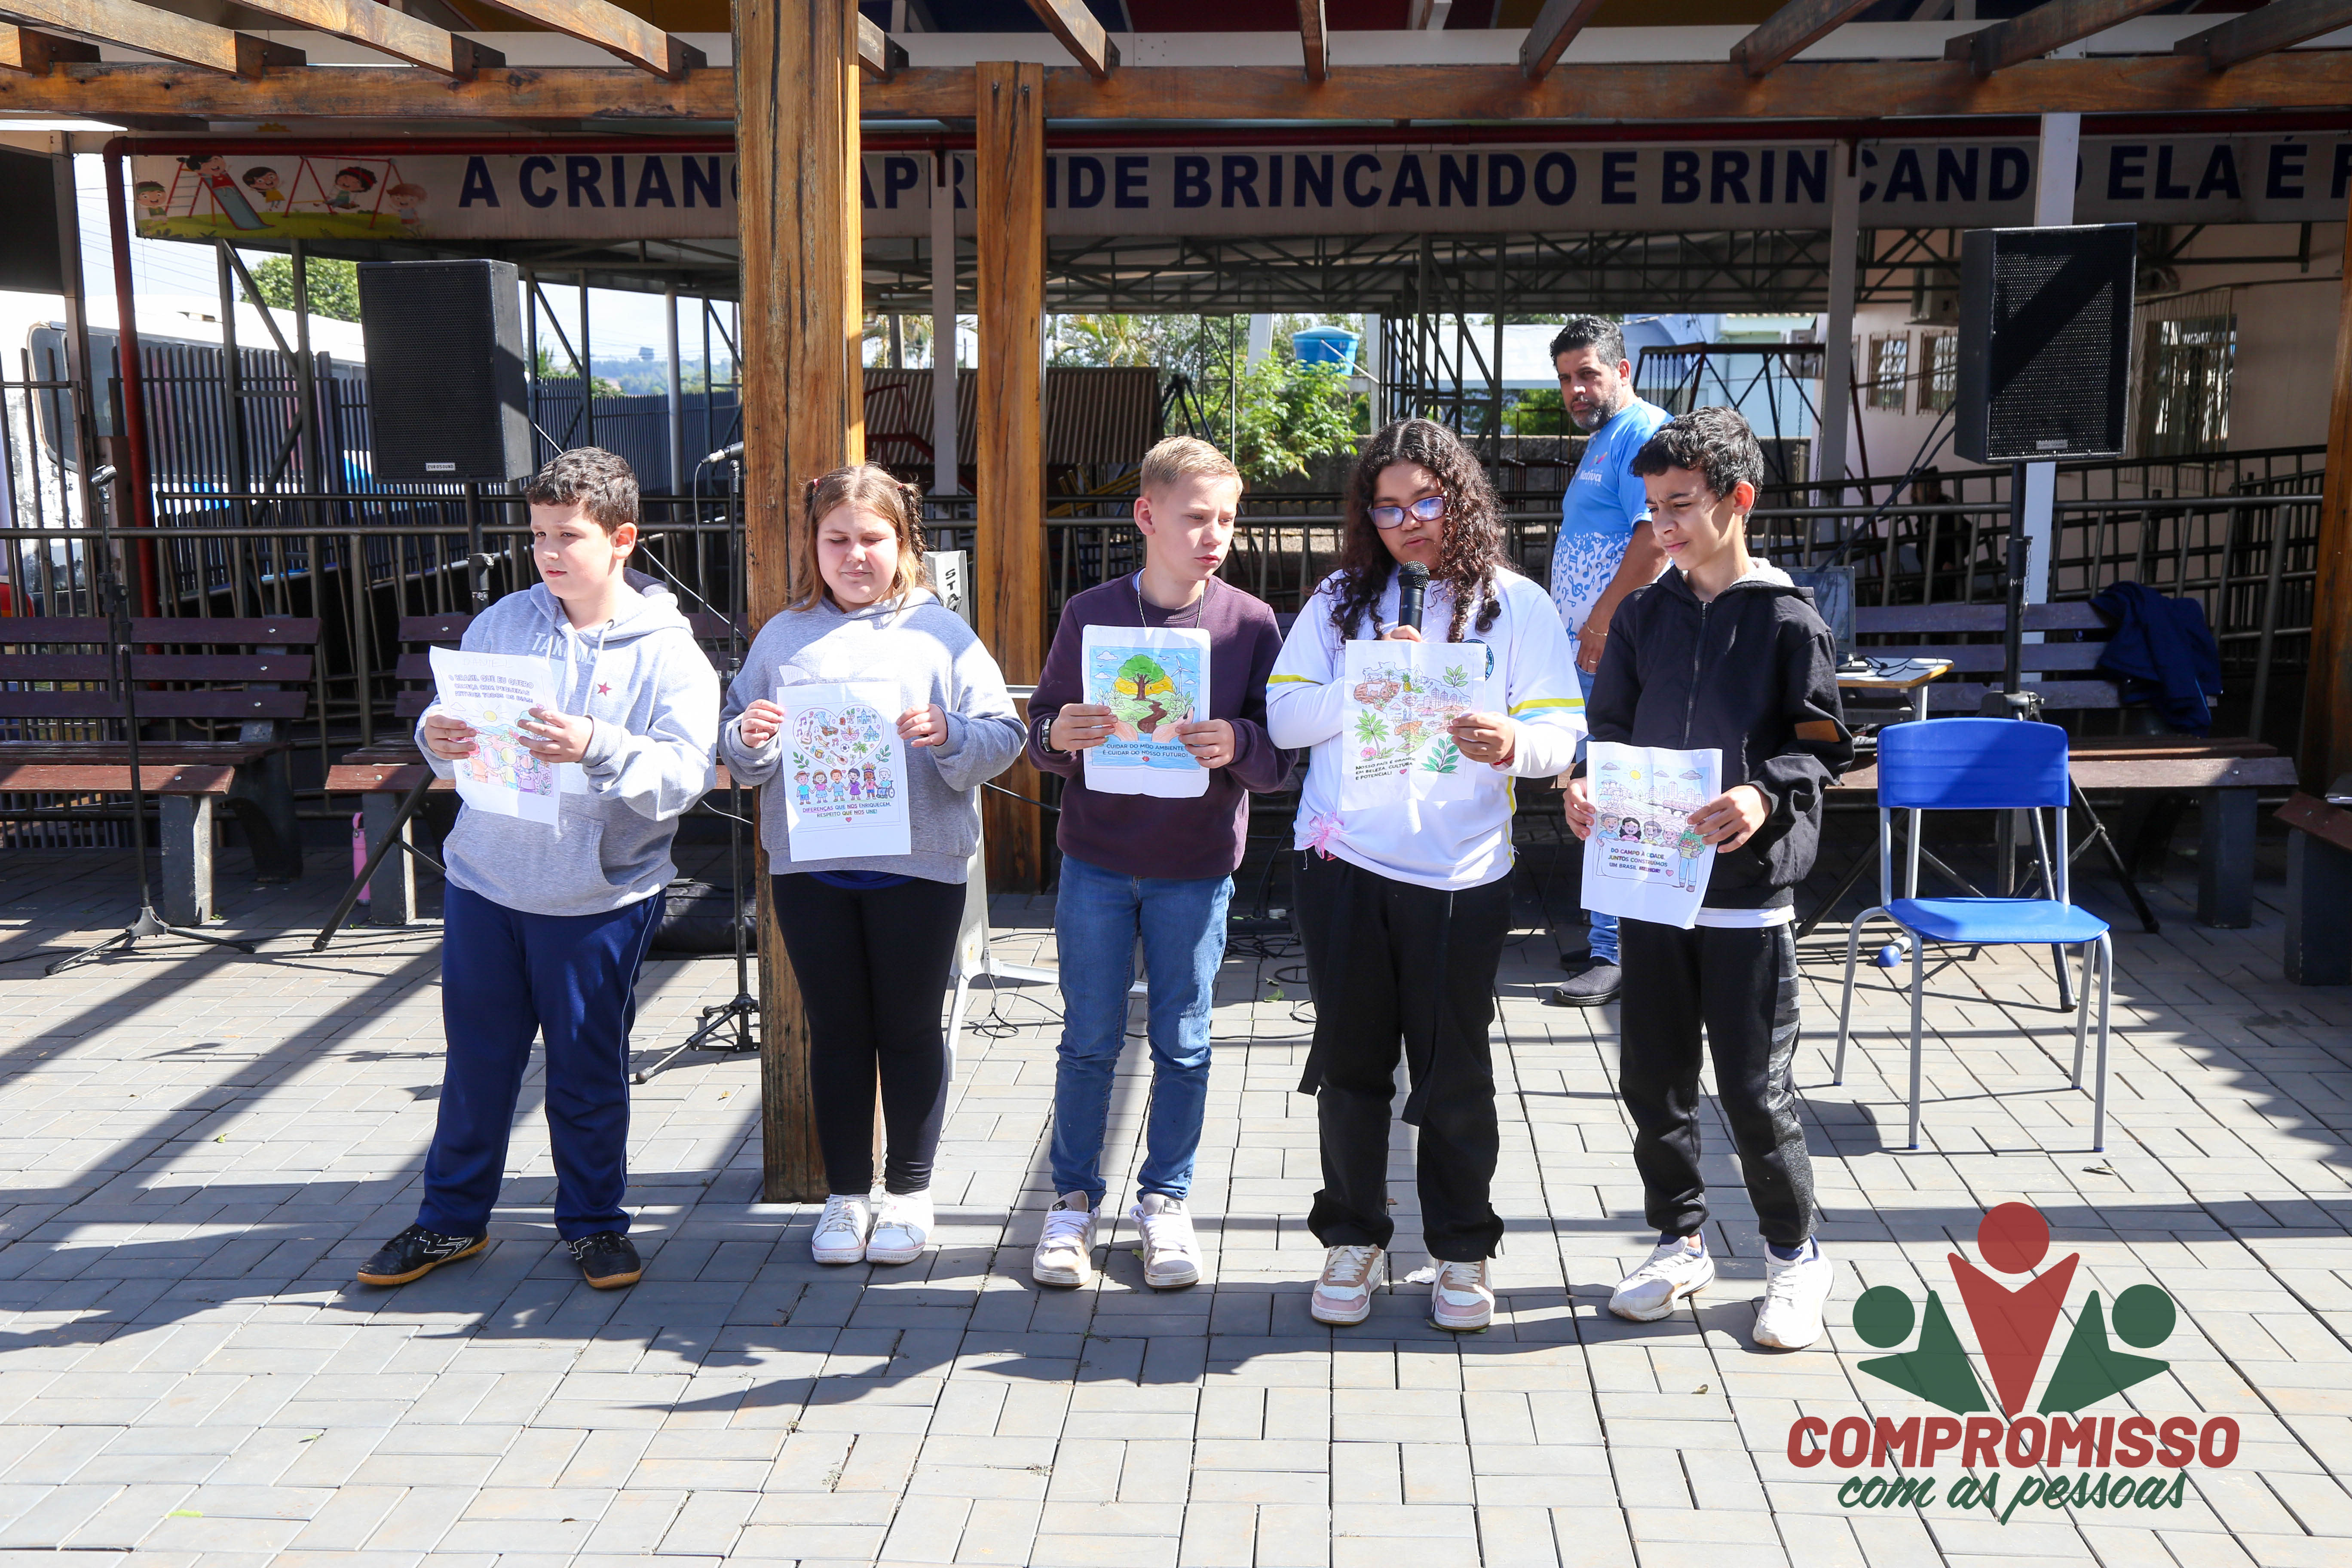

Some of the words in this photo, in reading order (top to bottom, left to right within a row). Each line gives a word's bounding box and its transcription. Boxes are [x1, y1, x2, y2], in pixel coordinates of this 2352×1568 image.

[459, 156, 500, 208] A
[519, 155, 738, 208] CRIAN
[1173, 151, 1577, 208] BRINCANDO
[1601, 151, 1637, 205] E
[1662, 147, 2083, 204] BRINAND
[2107, 144, 2241, 200] ELA
[2266, 135, 2308, 199] É
[1578, 469, 1602, 482] Nativa
[508, 678, 533, 689] QUERO
[496, 686, 530, 695] PEQUENAS
[1360, 771, 1392, 779] POTENCIAL!
[1630, 858, 1668, 867] CONSTRUÍMOS
